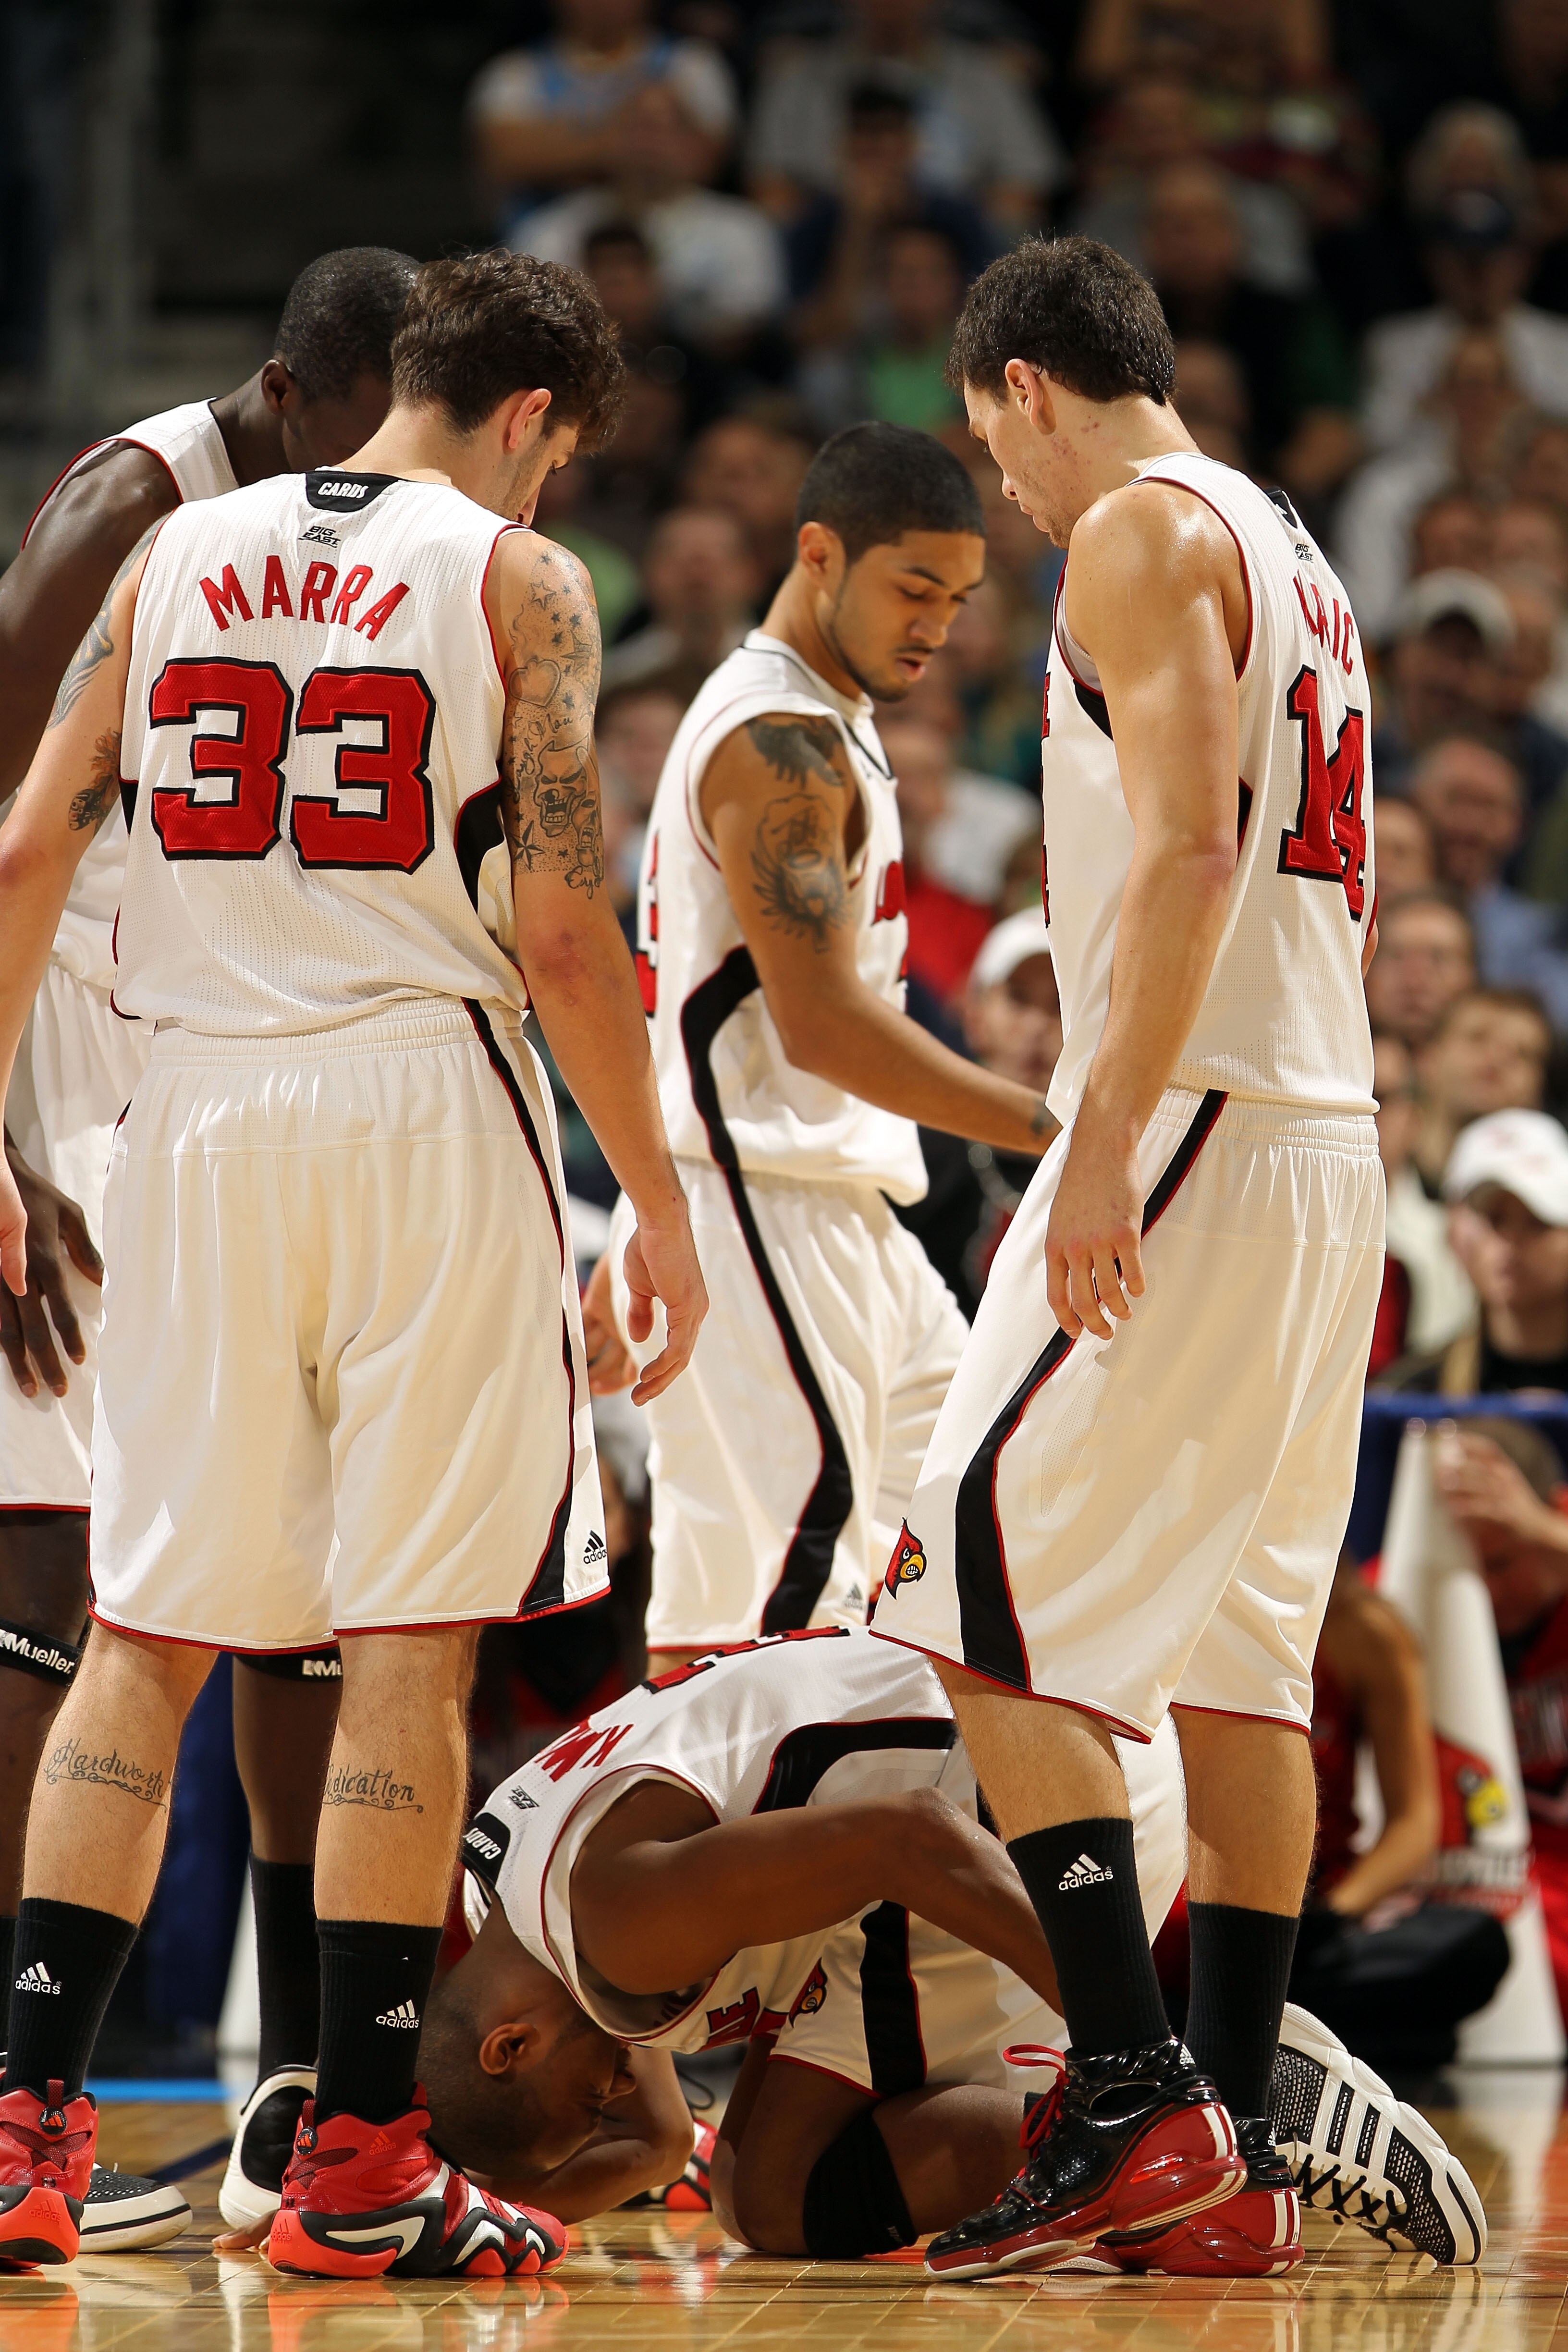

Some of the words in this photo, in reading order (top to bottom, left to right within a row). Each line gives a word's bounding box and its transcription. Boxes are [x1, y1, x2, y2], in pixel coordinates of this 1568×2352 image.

[318, 482, 369, 499] CARDS
[302, 532, 341, 546] EAST
[309, 526, 336, 537] BIG
[1295, 543, 1310, 552] BIG
[198, 555, 409, 642] MARRA
[150, 656, 437, 875] 33
[1277, 664, 1366, 923] 14
[4, 1632, 75, 1674] Mueller
[44, 1737, 164, 1798] Hardwork
[508, 1796, 527, 1809] BIG
[512, 1788, 535, 1808] EAST
[1058, 1871, 1114, 1890] adidas
[15, 1978, 61, 1995] adidas
[376, 2016, 419, 2029] adidas
[369, 2143, 396, 2155] adidas
[29, 2209, 61, 2222] adidas
